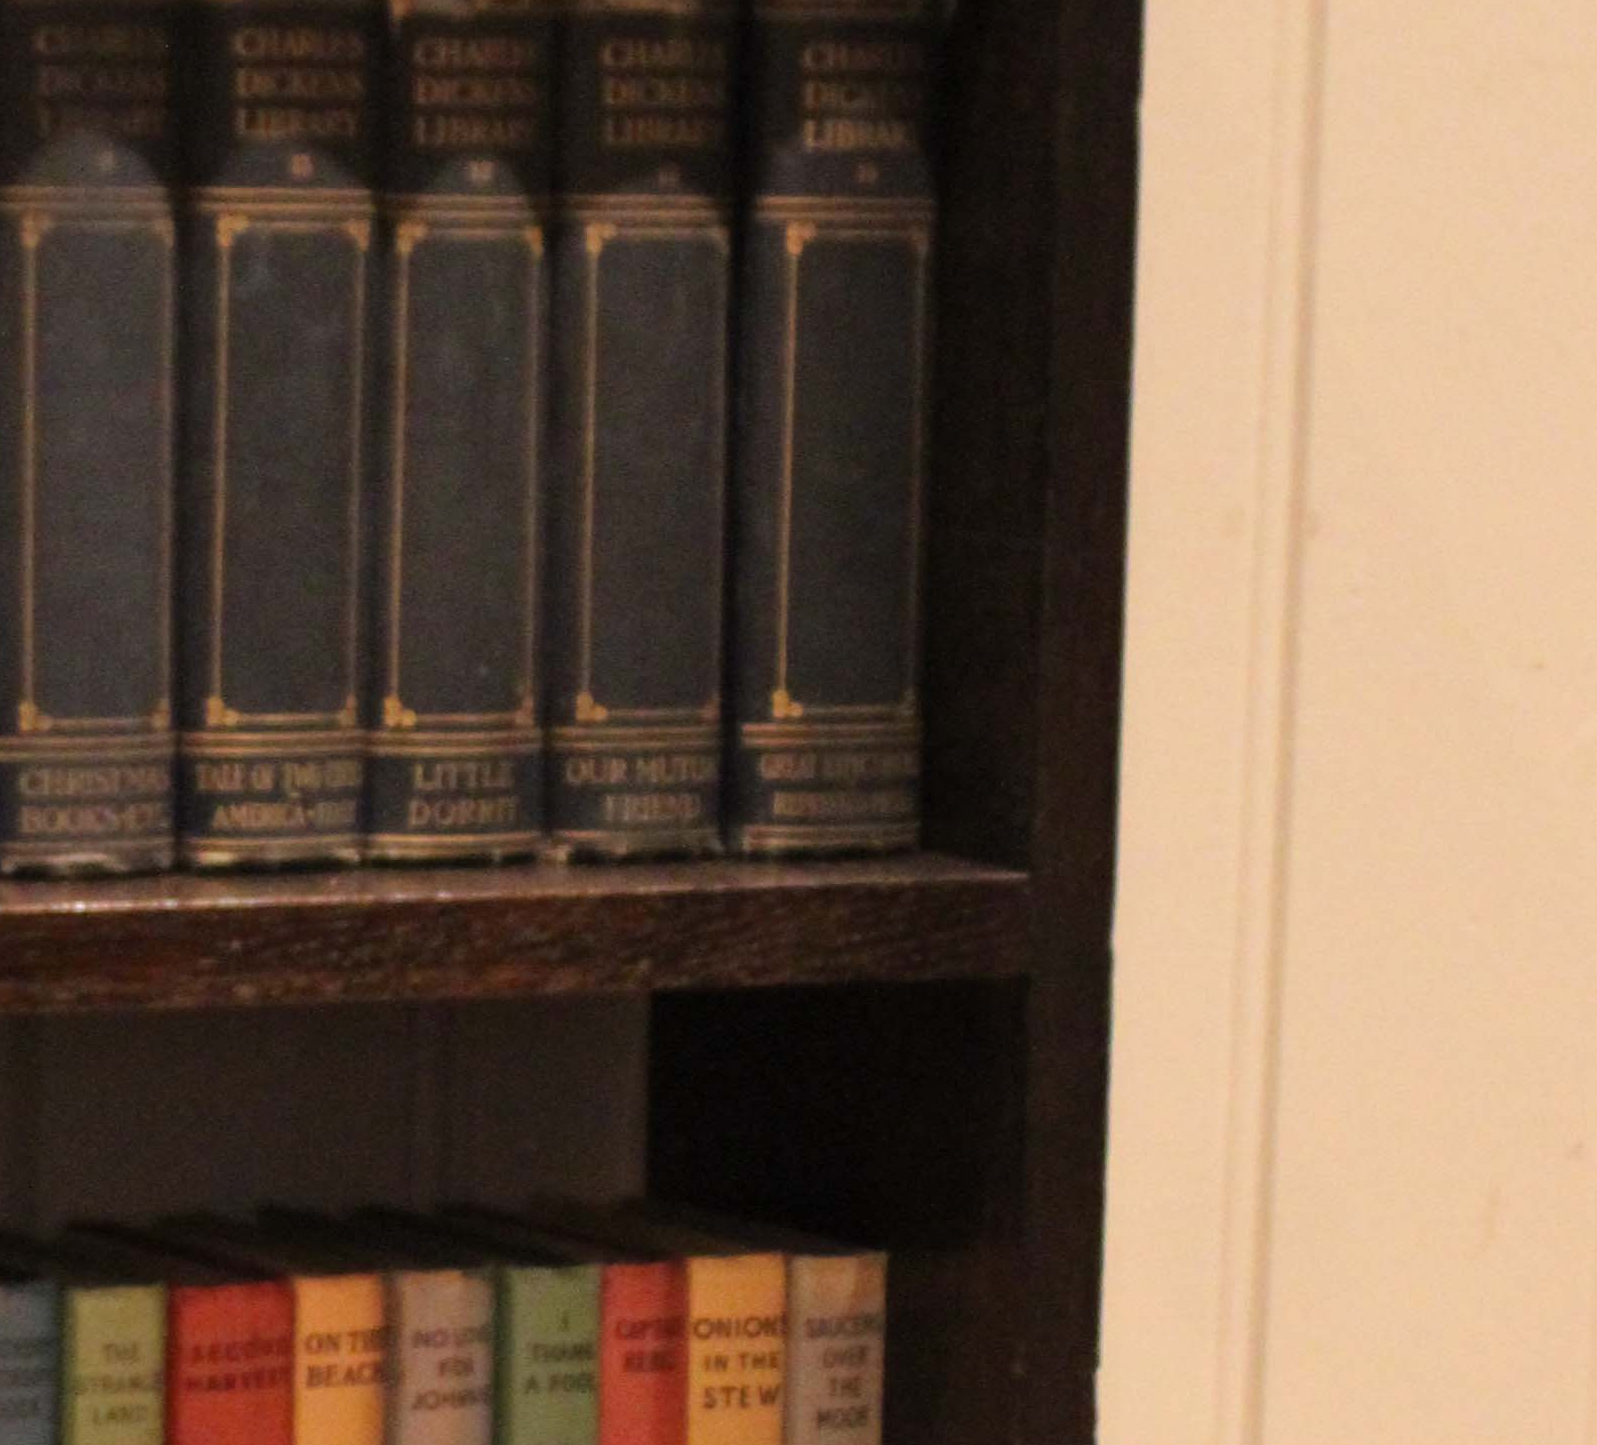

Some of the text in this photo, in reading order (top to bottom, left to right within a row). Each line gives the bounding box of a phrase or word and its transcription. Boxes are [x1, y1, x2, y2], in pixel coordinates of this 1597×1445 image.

[232, 27, 363, 57] CHARLES
[236, 67, 365, 96] DICKENS
[415, 76, 538, 105] DICKENS
[603, 75, 725, 106] DICKENS
[235, 108, 357, 139] LIBRARY
[413, 761, 516, 792] LITTLE
[564, 756, 627, 786] OUR
[407, 797, 521, 828] DORRIT
[102, 1342, 141, 1365] THE
[305, 1332, 341, 1356] ON
[412, 1328, 447, 1350] NO
[704, 1349, 781, 1372] IN THE
[524, 1376, 540, 1396] A
[702, 1382, 782, 1411] STEW
[828, 1374, 862, 1398] THE
